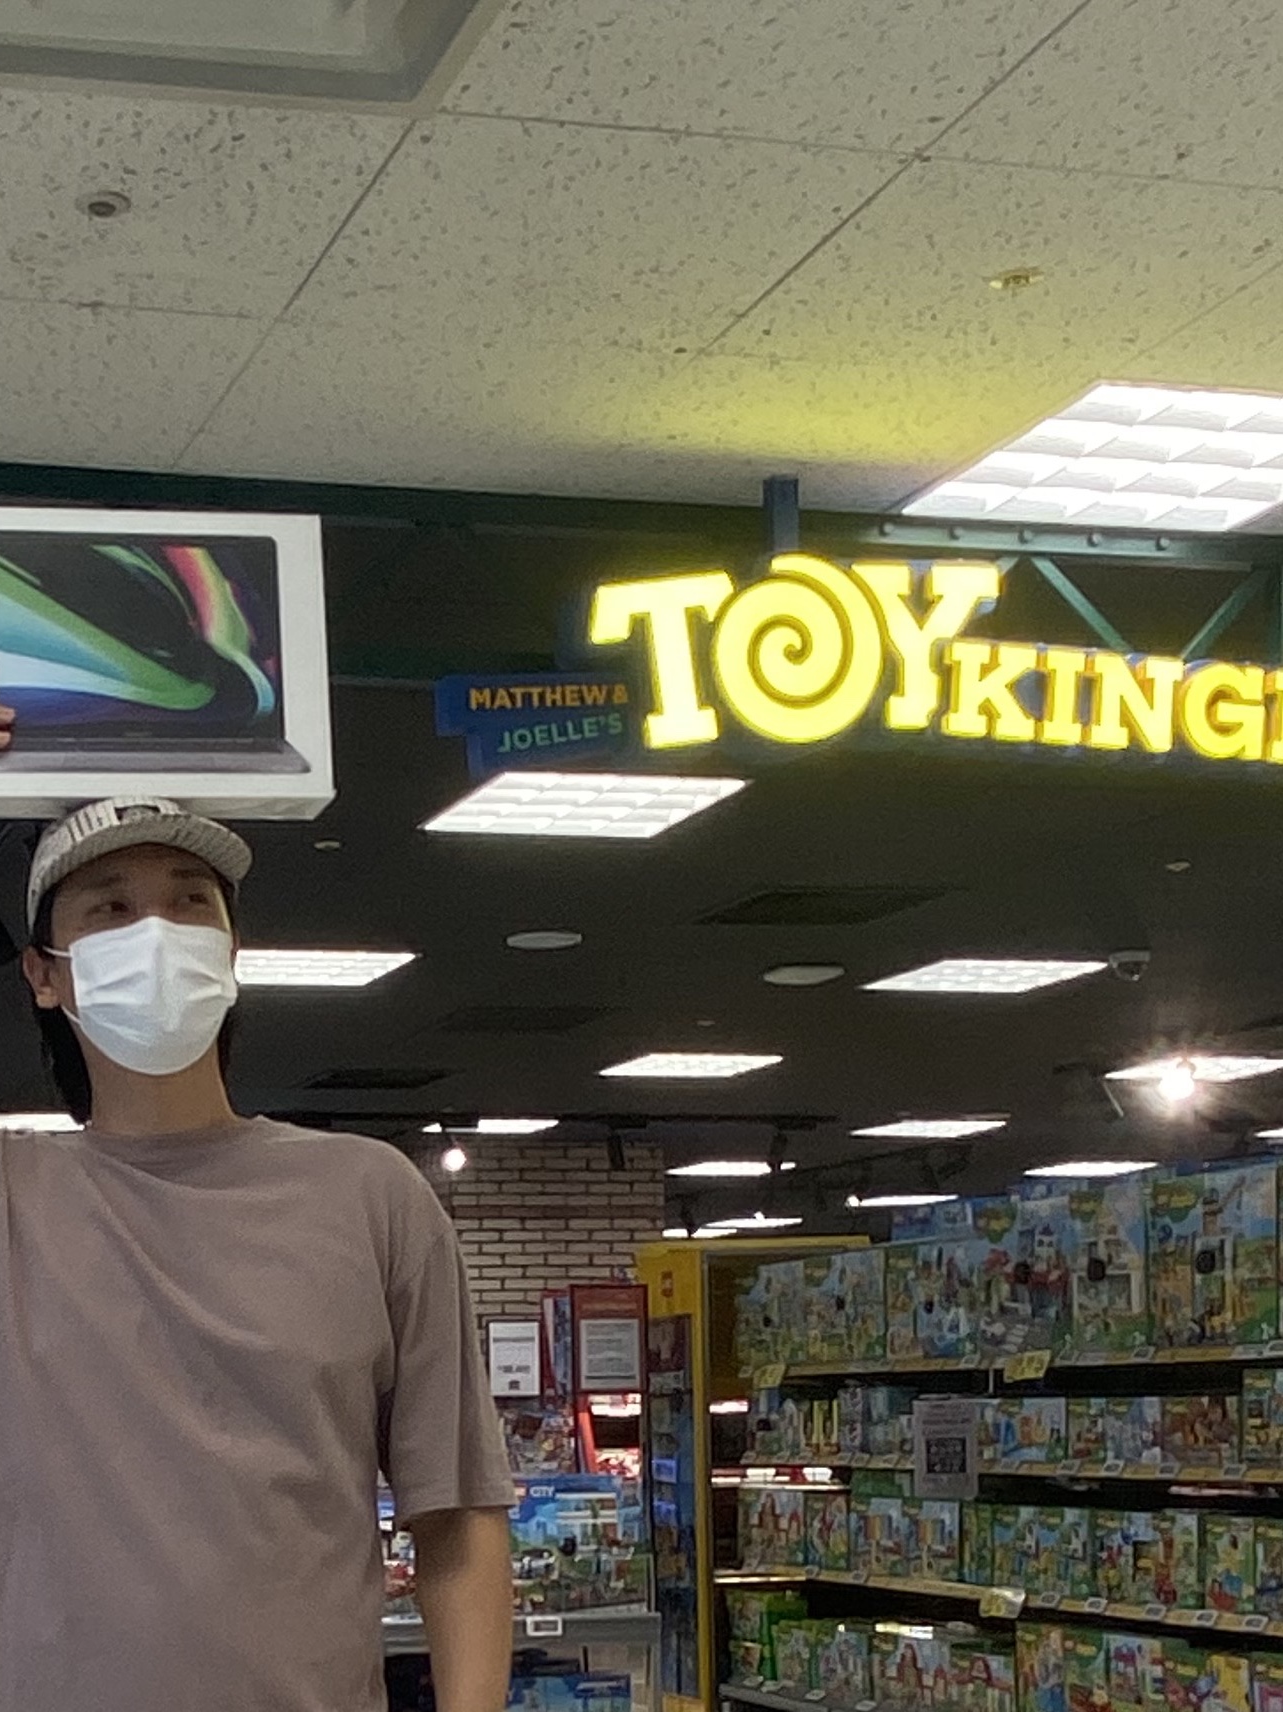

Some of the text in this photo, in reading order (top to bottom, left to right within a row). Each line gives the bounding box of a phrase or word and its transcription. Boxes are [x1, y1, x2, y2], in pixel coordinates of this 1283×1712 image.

[588, 551, 1283, 765] TOY KING
[469, 683, 628, 712] MATTHEW &
[496, 712, 623, 753] JOELLE'S
